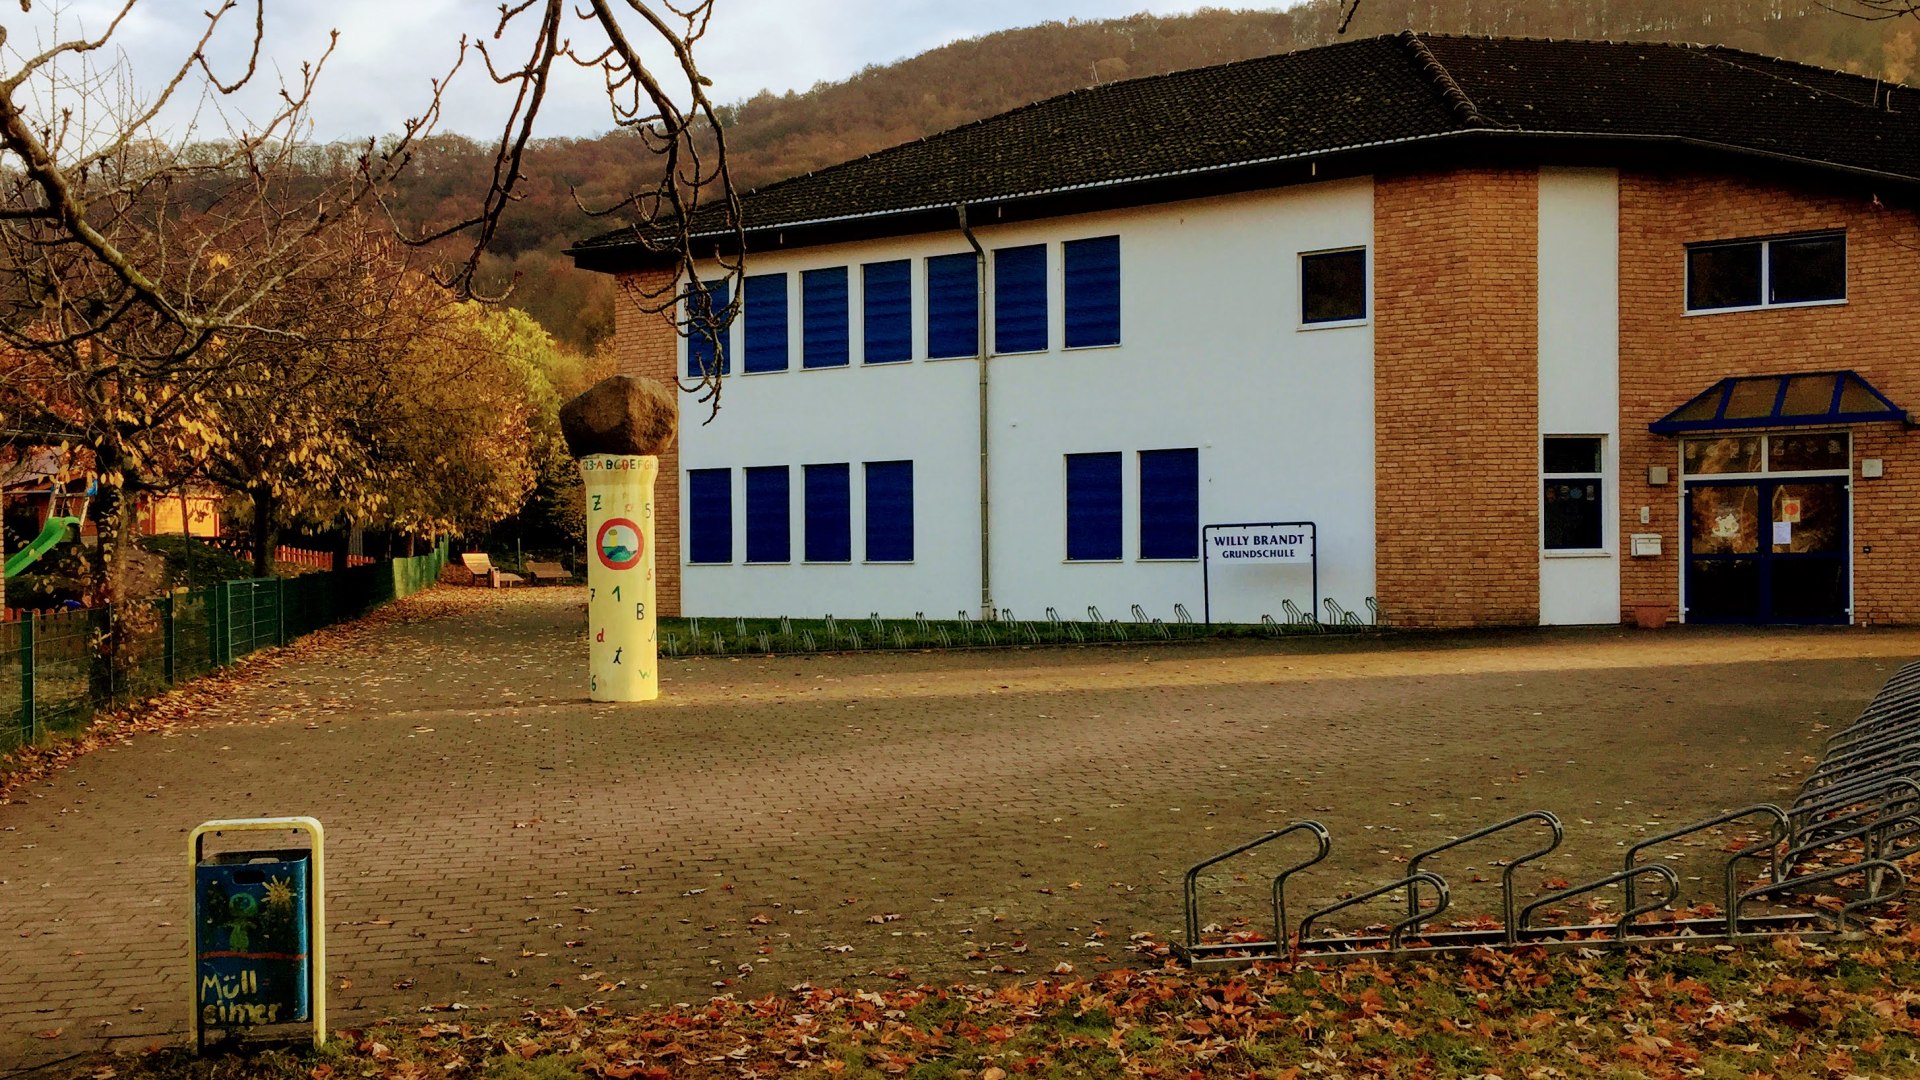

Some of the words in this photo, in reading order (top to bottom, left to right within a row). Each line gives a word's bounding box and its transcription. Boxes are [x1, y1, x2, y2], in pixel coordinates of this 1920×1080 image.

[645, 502, 652, 519] 5
[1214, 535, 1250, 546] WILLY
[1253, 534, 1305, 546] BRANDT
[1222, 549, 1296, 559] GRUNDSCHULE
[590, 588, 596, 602] 7
[611, 585, 621, 602] 1
[636, 602, 645, 620] B
[596, 627, 605, 643] d
[591, 674, 597, 692] 6
[201, 970, 257, 1001] Müll
[203, 1000, 282, 1025] eimer
